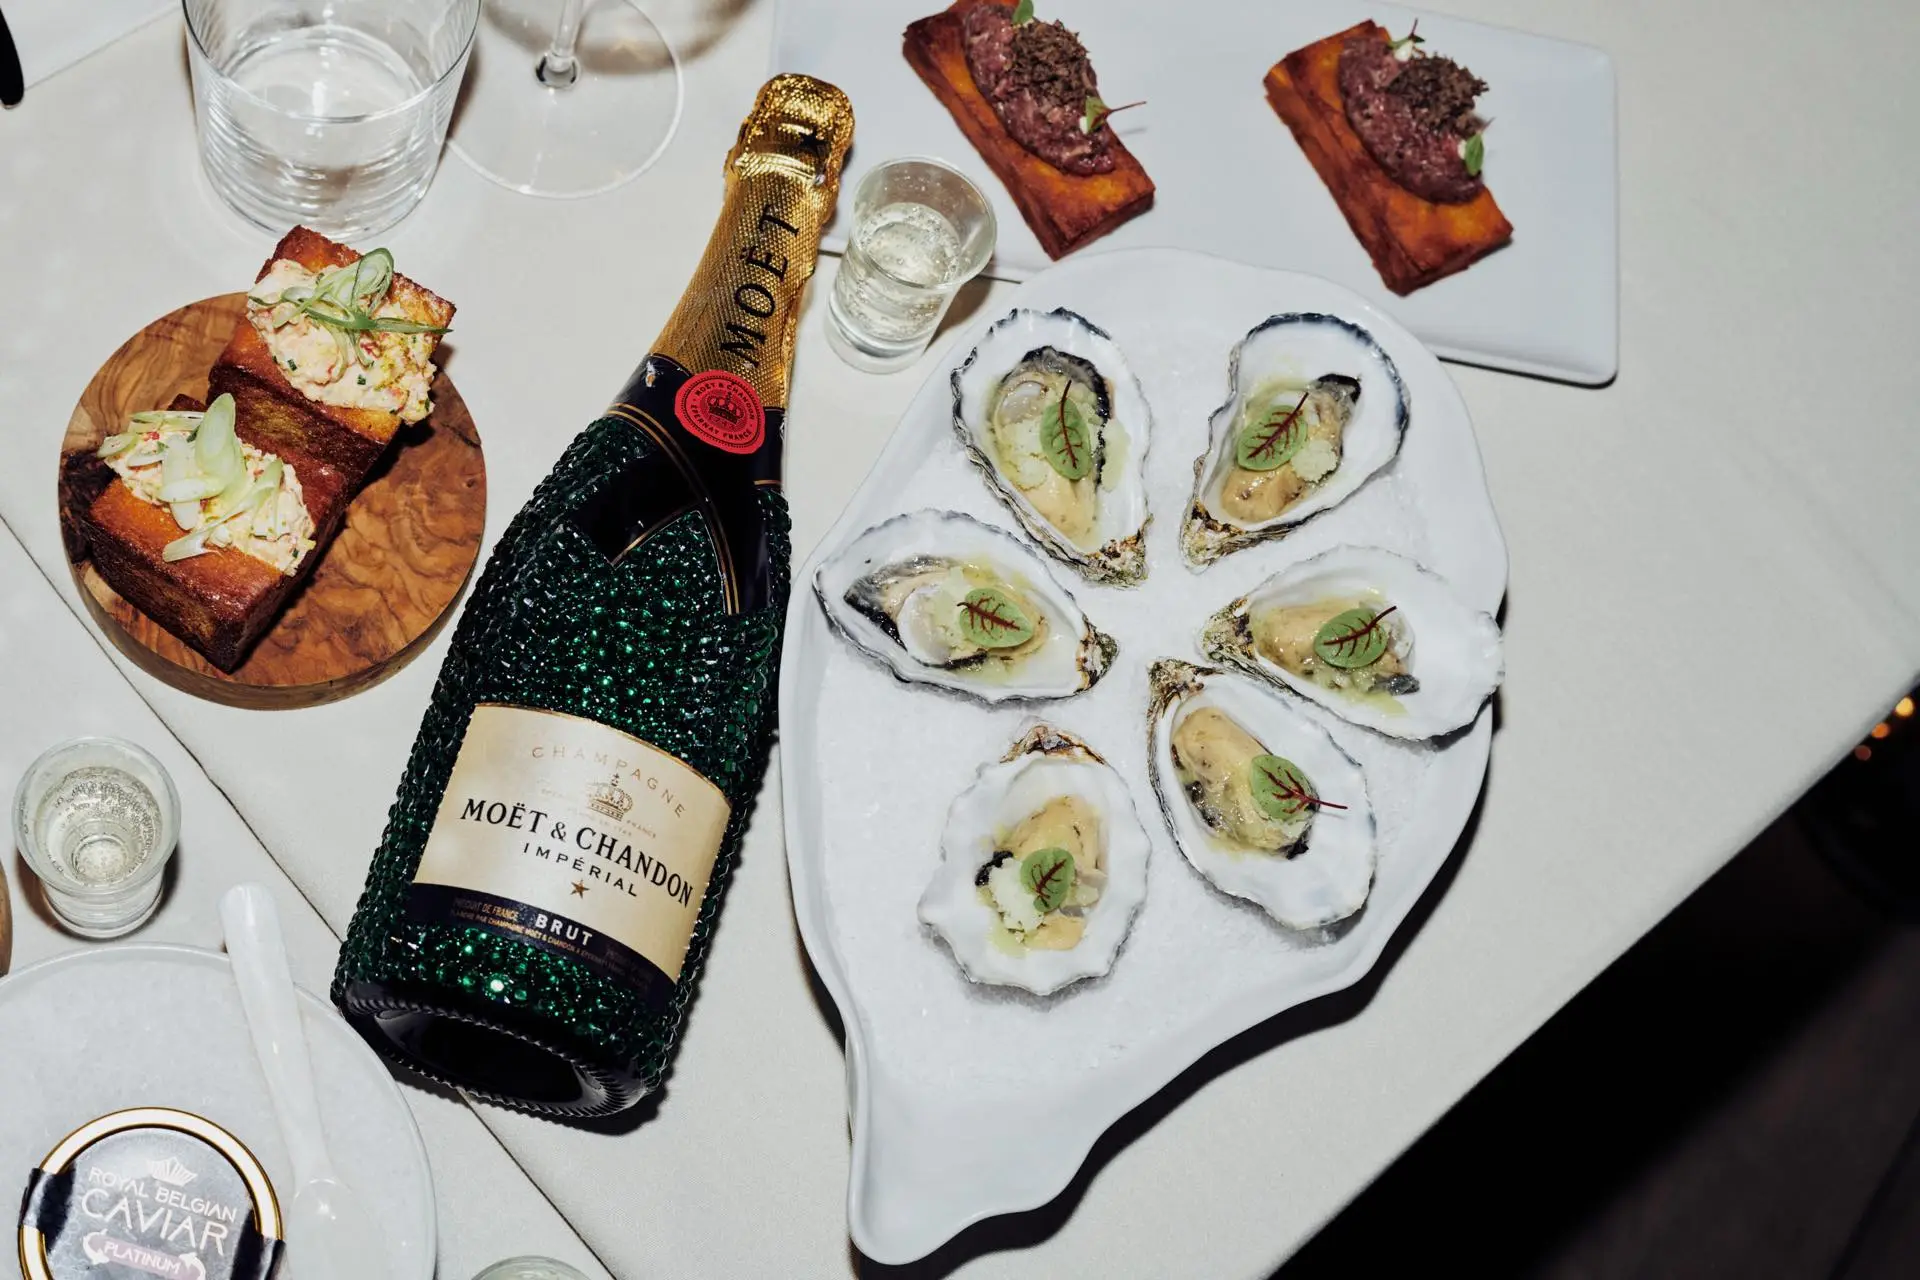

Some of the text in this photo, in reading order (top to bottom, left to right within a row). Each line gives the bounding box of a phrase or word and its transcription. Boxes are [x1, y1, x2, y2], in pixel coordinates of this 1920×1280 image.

[720, 204, 799, 367] MOËT
[726, 384, 755, 420] CHANDON
[722, 430, 752, 441] FRANCE
[531, 745, 686, 818] CHAMPAGNE
[460, 798, 547, 834] MOËT
[550, 820, 568, 842] &
[575, 826, 694, 909] CHANDON
[523, 842, 638, 898] IMPÉRIAL
[492, 905, 519, 921] FRANCE
[535, 913, 593, 946] BRUT
[81, 1187, 230, 1256] CAVIAR
[88, 1166, 237, 1223] ROYAL BELGIAN
[103, 1241, 181, 1275] PLATINUM
